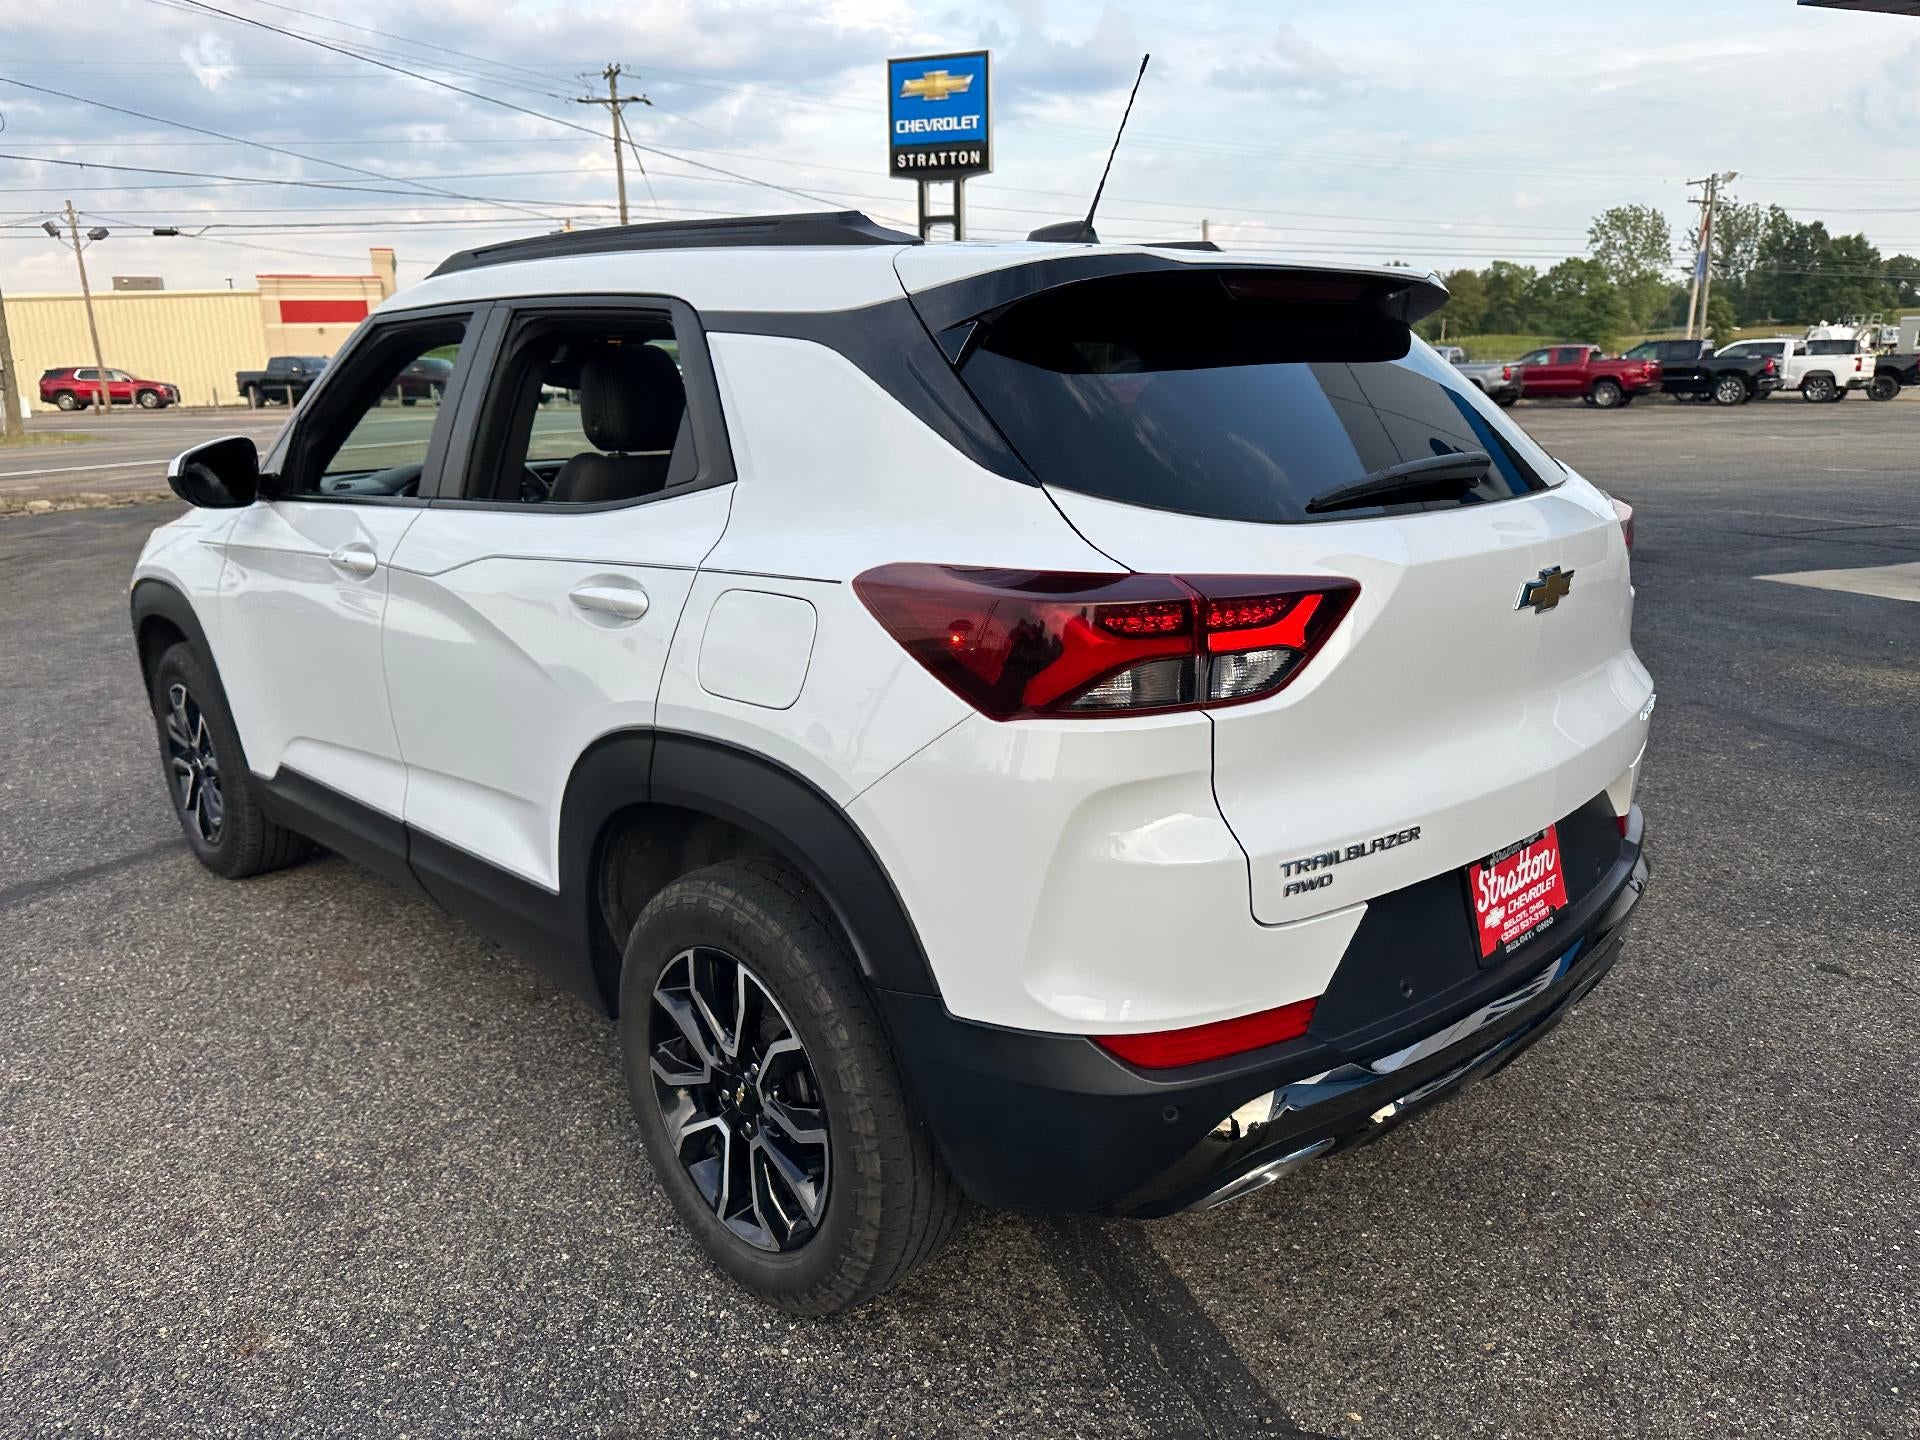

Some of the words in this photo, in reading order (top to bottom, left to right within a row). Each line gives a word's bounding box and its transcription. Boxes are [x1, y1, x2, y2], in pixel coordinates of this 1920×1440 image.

[896, 115, 980, 133] CHEVROLET
[897, 150, 980, 168] STRATTON
[1281, 825, 1421, 877] TRAILBLAZER
[1283, 873, 1333, 897] AWD
[1477, 847, 1556, 912] Stratton
[1508, 874, 1557, 914] CHEVROLET
[1528, 899, 1544, 914] OHIO
[1536, 917, 1554, 932] OHIO
[1501, 926, 1520, 942] (330)
